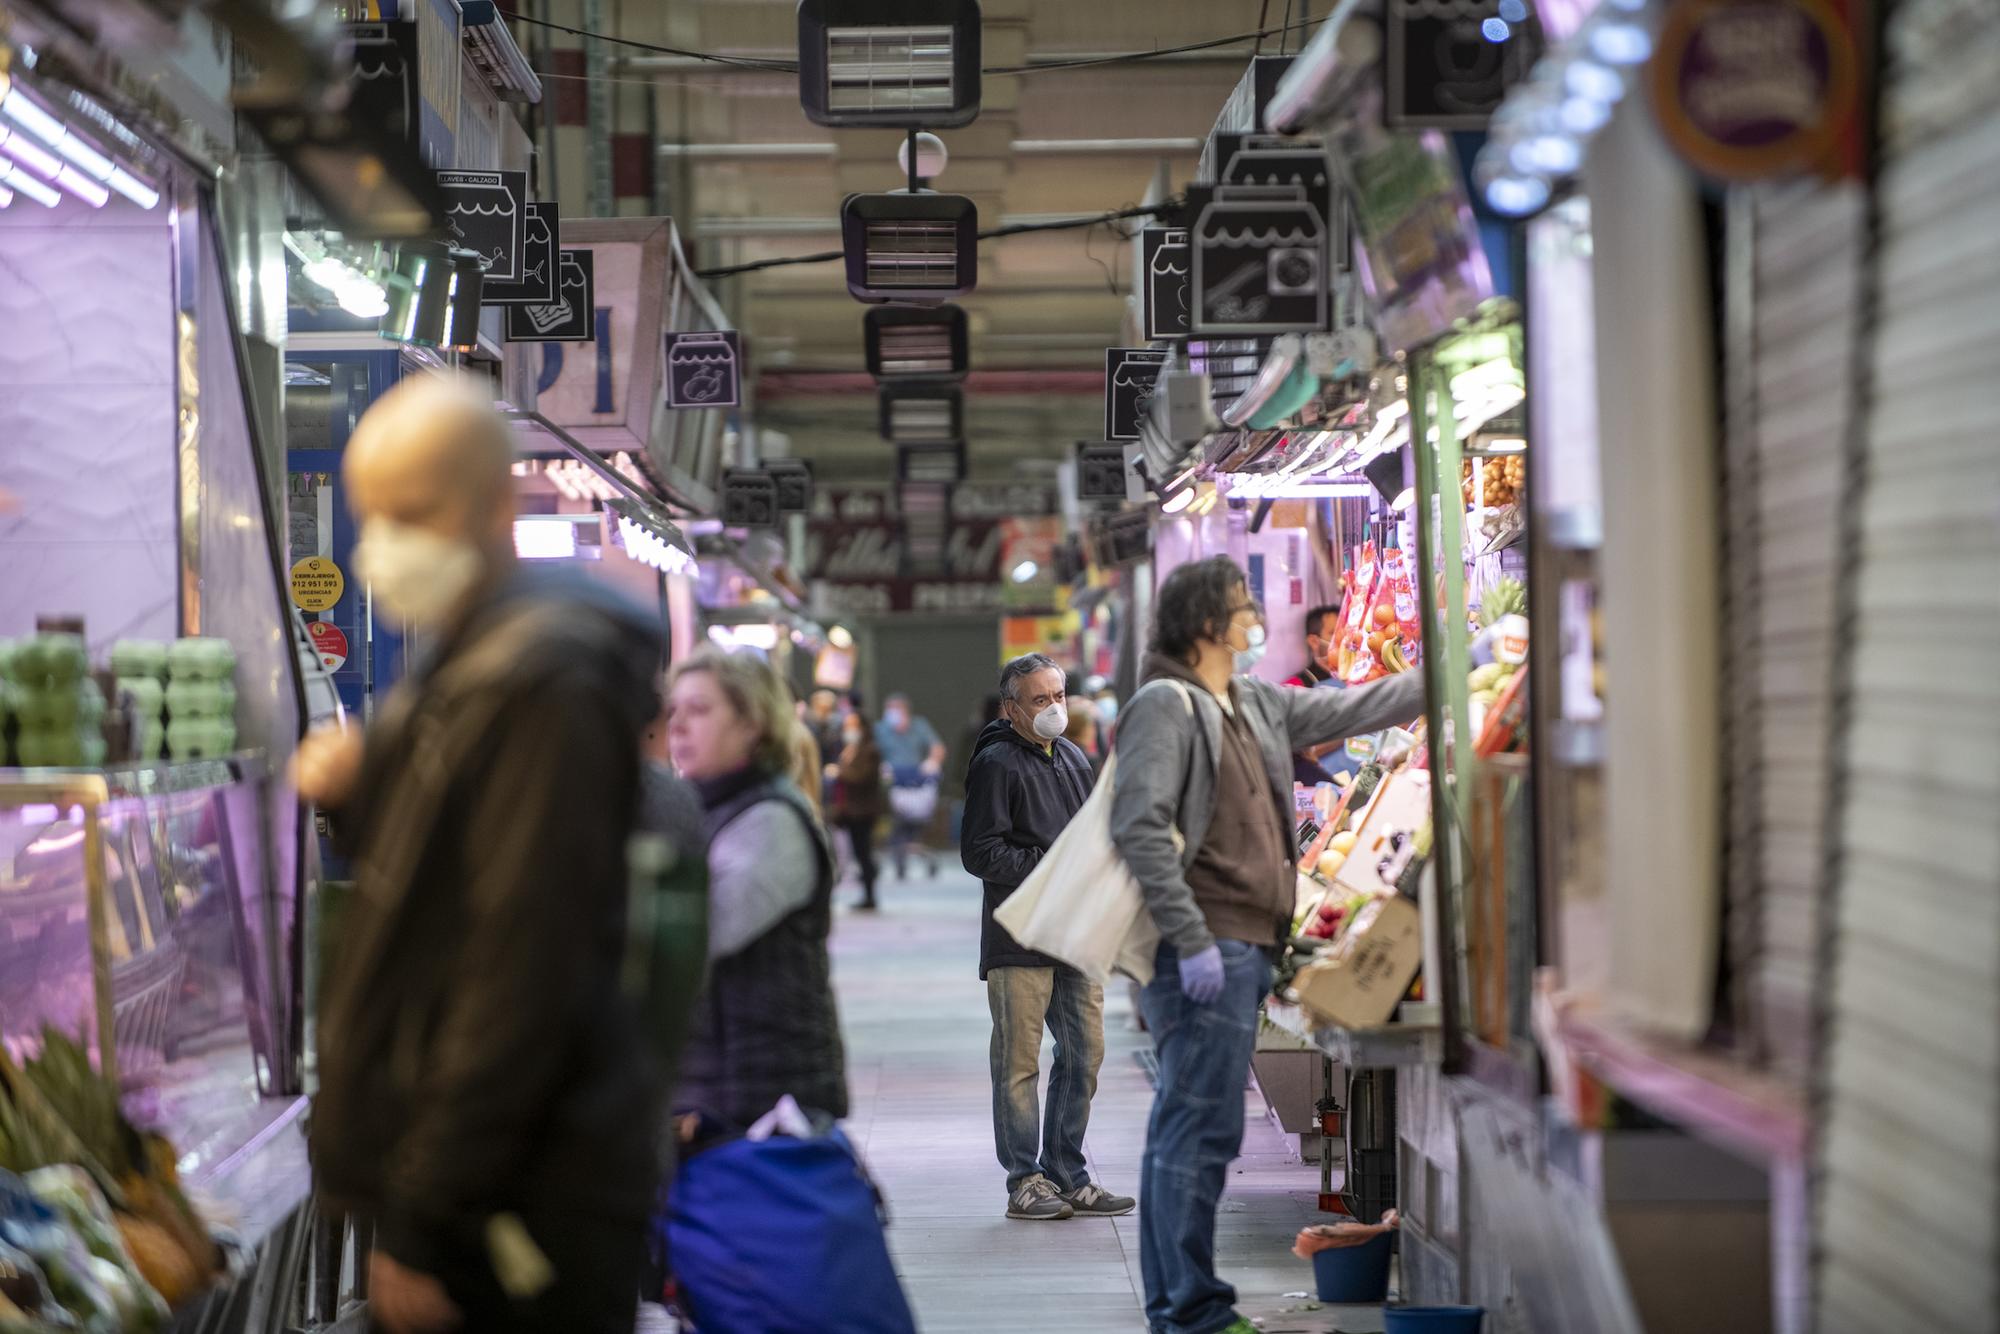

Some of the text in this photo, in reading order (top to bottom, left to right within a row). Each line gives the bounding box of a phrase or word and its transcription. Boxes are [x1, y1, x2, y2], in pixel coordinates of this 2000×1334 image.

[468, 176, 498, 184] CALZADO
[292, 580, 338, 588] 912 951 593
